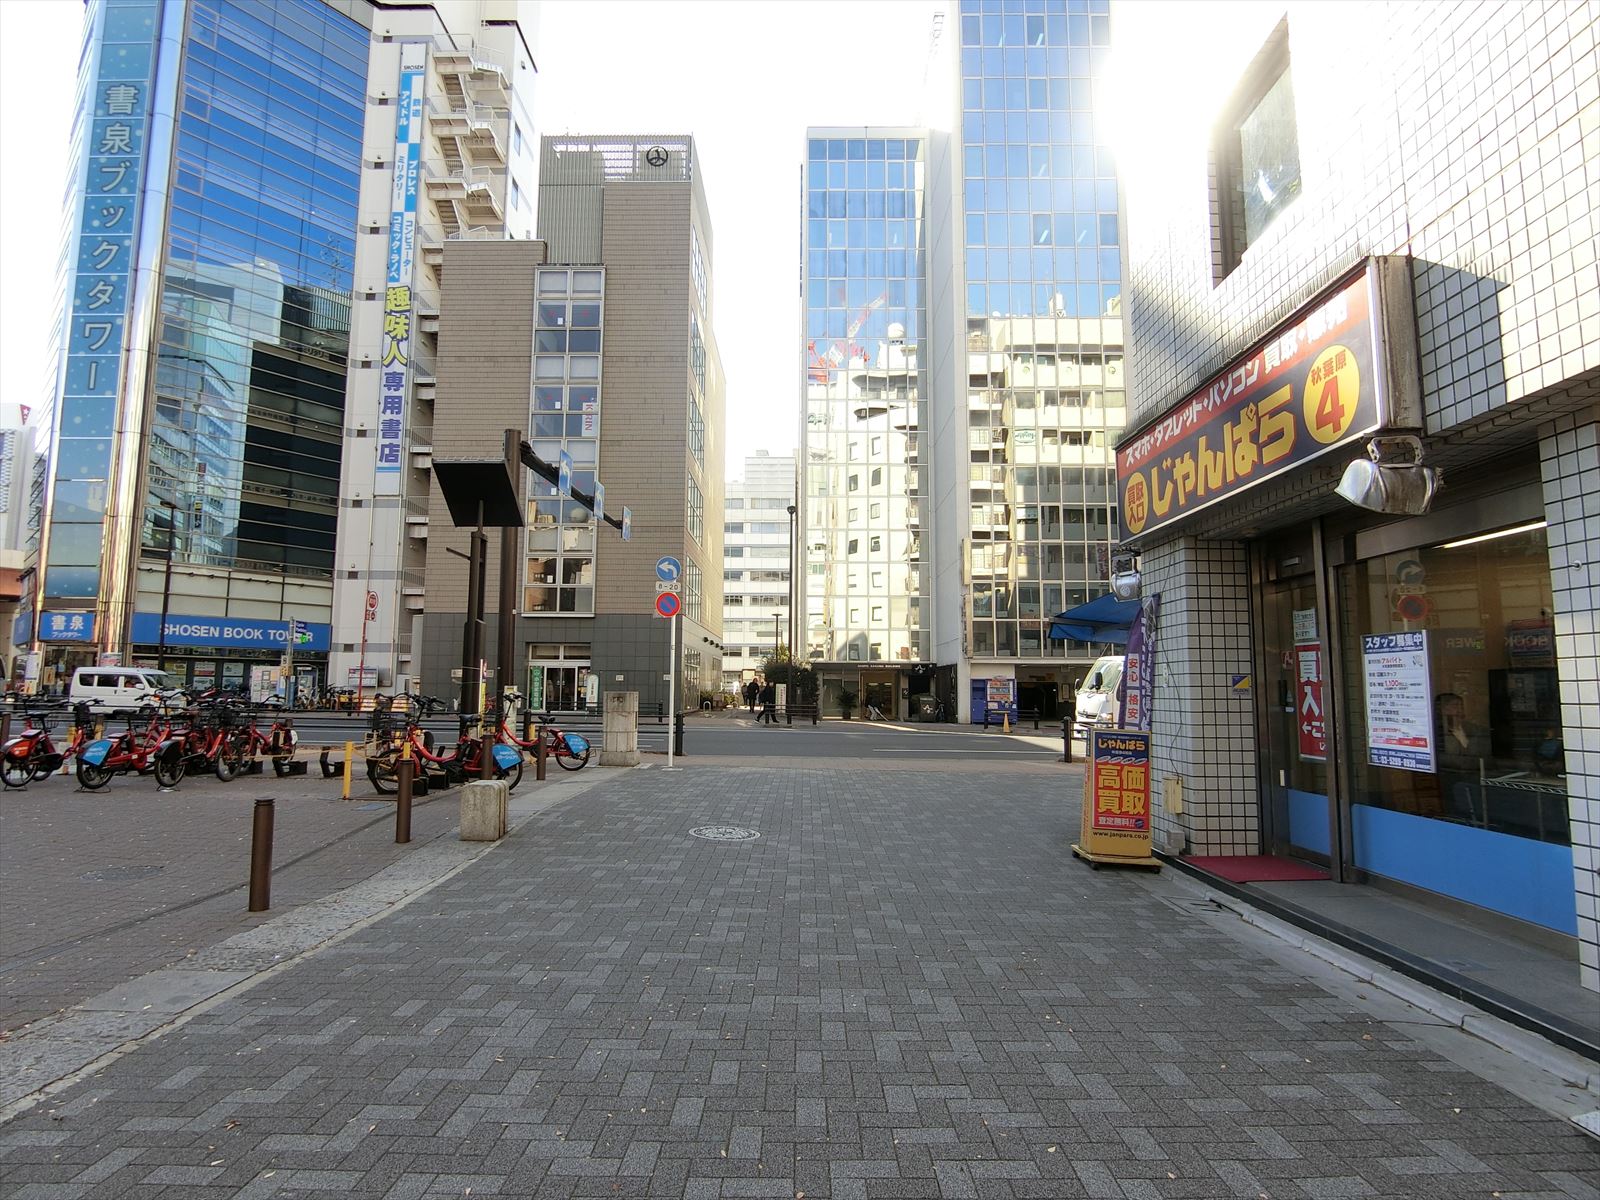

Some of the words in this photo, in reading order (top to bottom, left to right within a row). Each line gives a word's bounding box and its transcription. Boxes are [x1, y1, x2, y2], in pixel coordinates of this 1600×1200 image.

[400, 91, 410, 126] アイドル
[396, 155, 405, 200] ミリタリー
[407, 160, 418, 195] プロレス
[84, 82, 140, 391] 書泉ブックタワー
[378, 287, 411, 463] 趣味人専用書店
[1310, 348, 1347, 386] 秋葉原
[585, 404, 593, 431] KIRIN
[1315, 377, 1346, 434] 4
[1151, 383, 1296, 519] じゃんぱら
[1129, 502, 1145, 527] 入口
[51, 614, 84, 631] 書泉
[223, 627, 263, 639] BOOK
[268, 629, 313, 642] TOR
[1365, 633, 1422, 648] スタッフ募集中
[1128, 658, 1139, 680] 安心
[1128, 693, 1138, 719] 格安
[1098, 738, 1145, 751] じゃんぱら
[1097, 764, 1145, 790] 高価
[1097, 789, 1145, 815] 買取
[1093, 830, 1149, 840] www.janpara.co.jp
